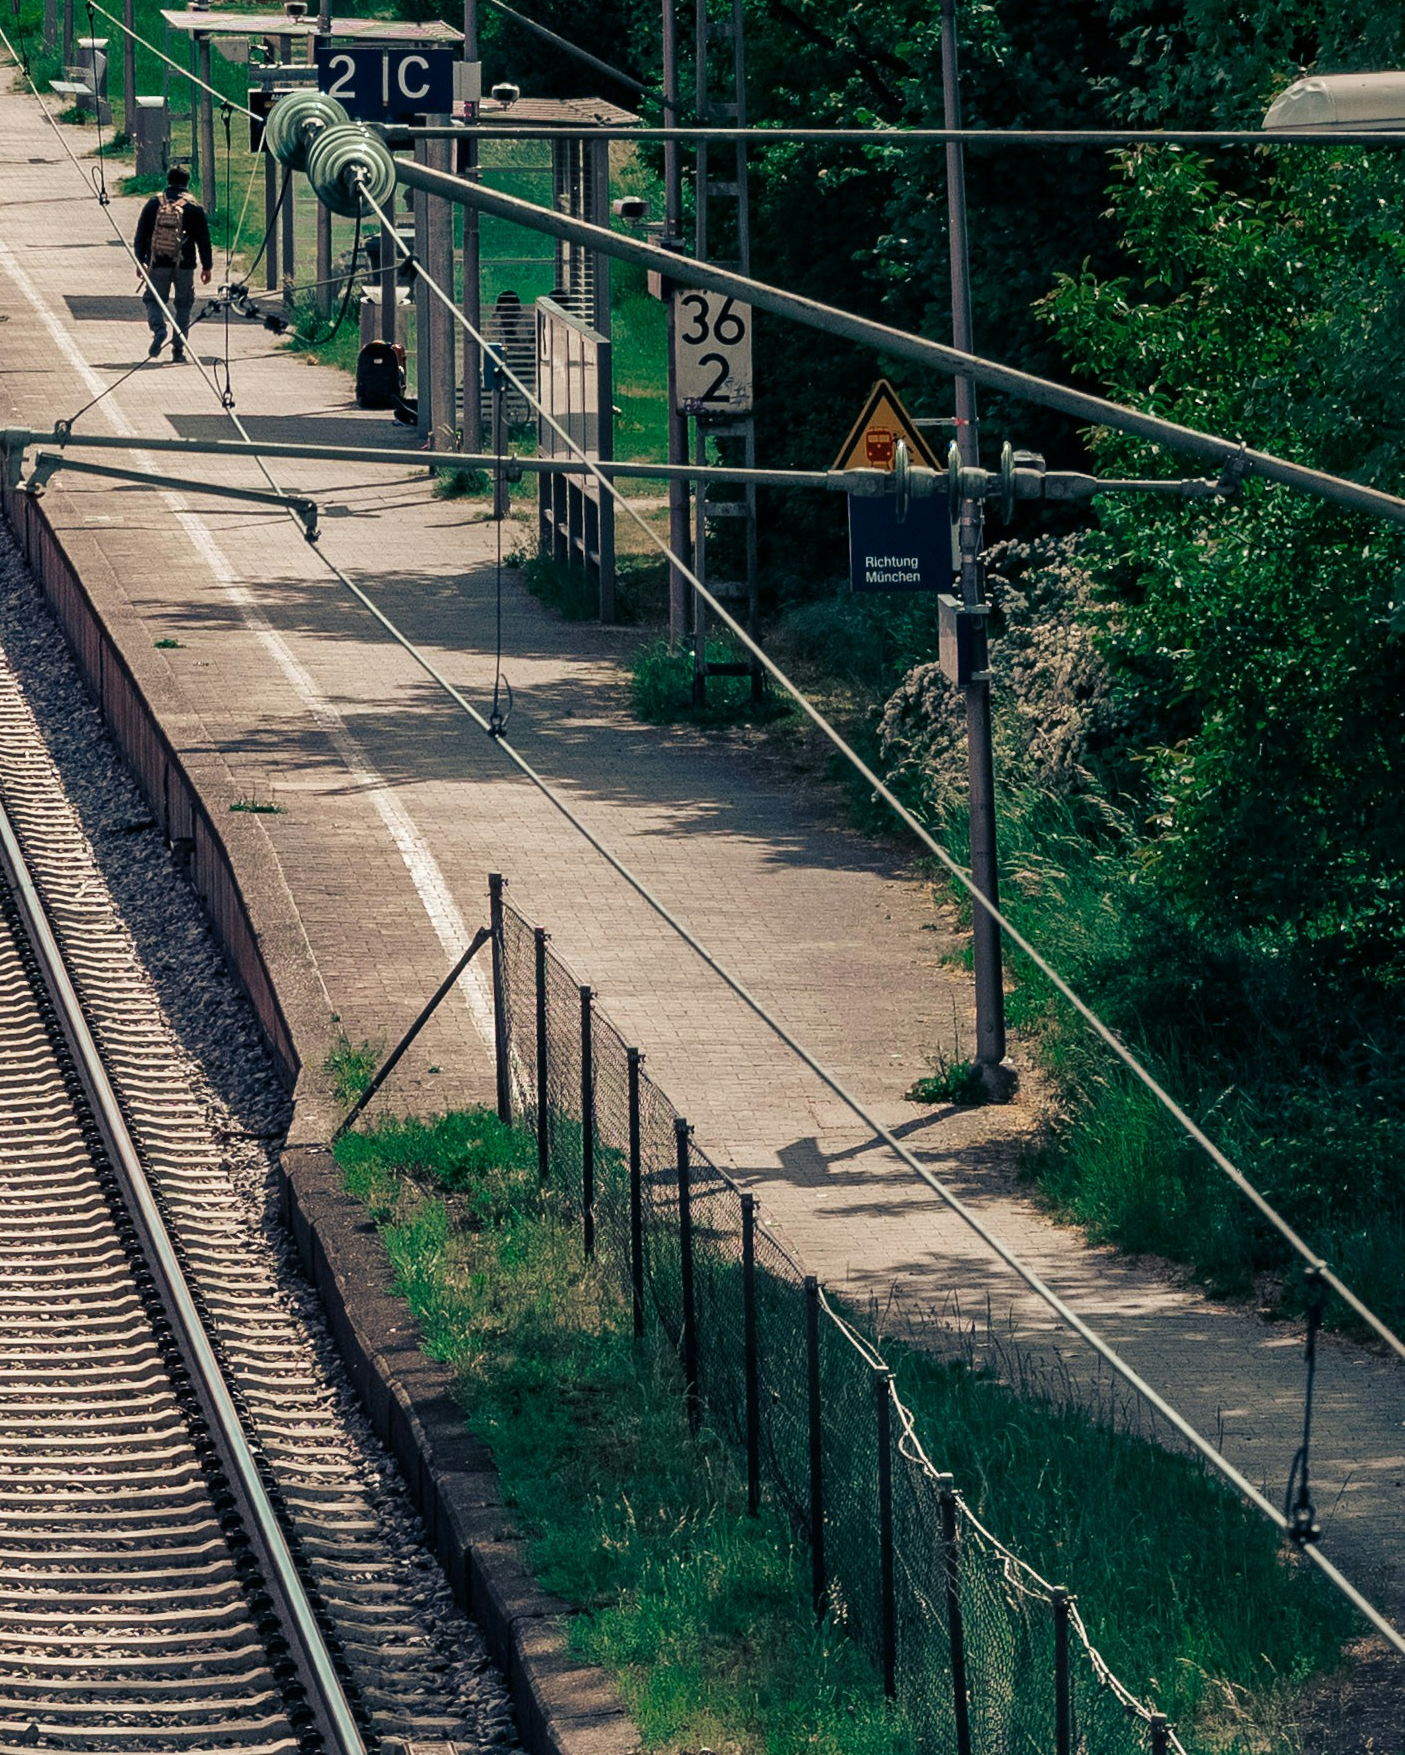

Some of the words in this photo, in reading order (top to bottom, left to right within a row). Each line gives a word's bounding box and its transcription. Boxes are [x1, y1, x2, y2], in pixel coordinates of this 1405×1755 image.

[328, 54, 356, 98] 2
[397, 55, 430, 99] C
[680, 294, 745, 345] 36
[698, 352, 730, 403] 2
[865, 556, 919, 569] Richtung
[865, 571, 921, 583] München
